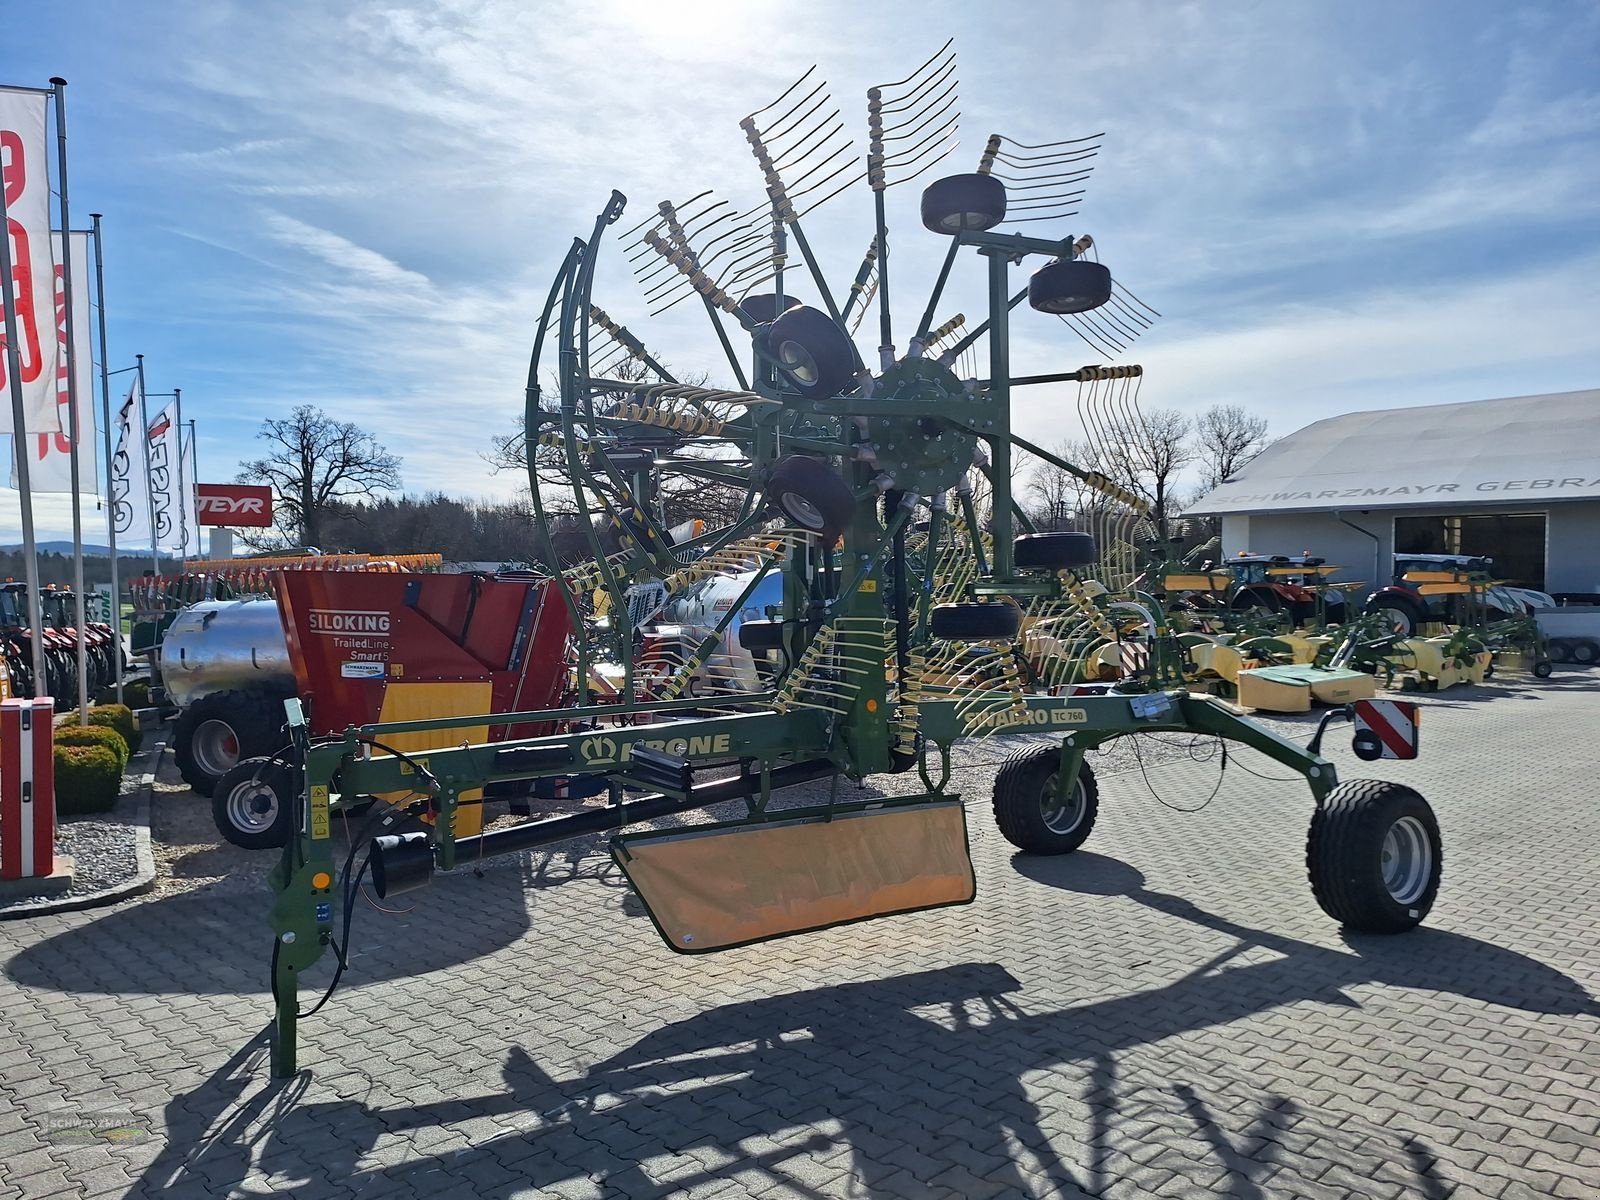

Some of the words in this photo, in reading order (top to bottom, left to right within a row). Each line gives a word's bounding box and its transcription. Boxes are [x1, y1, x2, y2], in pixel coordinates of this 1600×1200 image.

[1211, 483, 1461, 505] SCHWARZMAYR
[198, 495, 264, 514] TEYR
[309, 613, 390, 631] SILOKING
[333, 637, 389, 649] TrailedLine
[350, 650, 382, 661] Smart
[383, 651, 389, 661] 5
[1054, 712, 1066, 721] TC
[1067, 711, 1083, 721] 760
